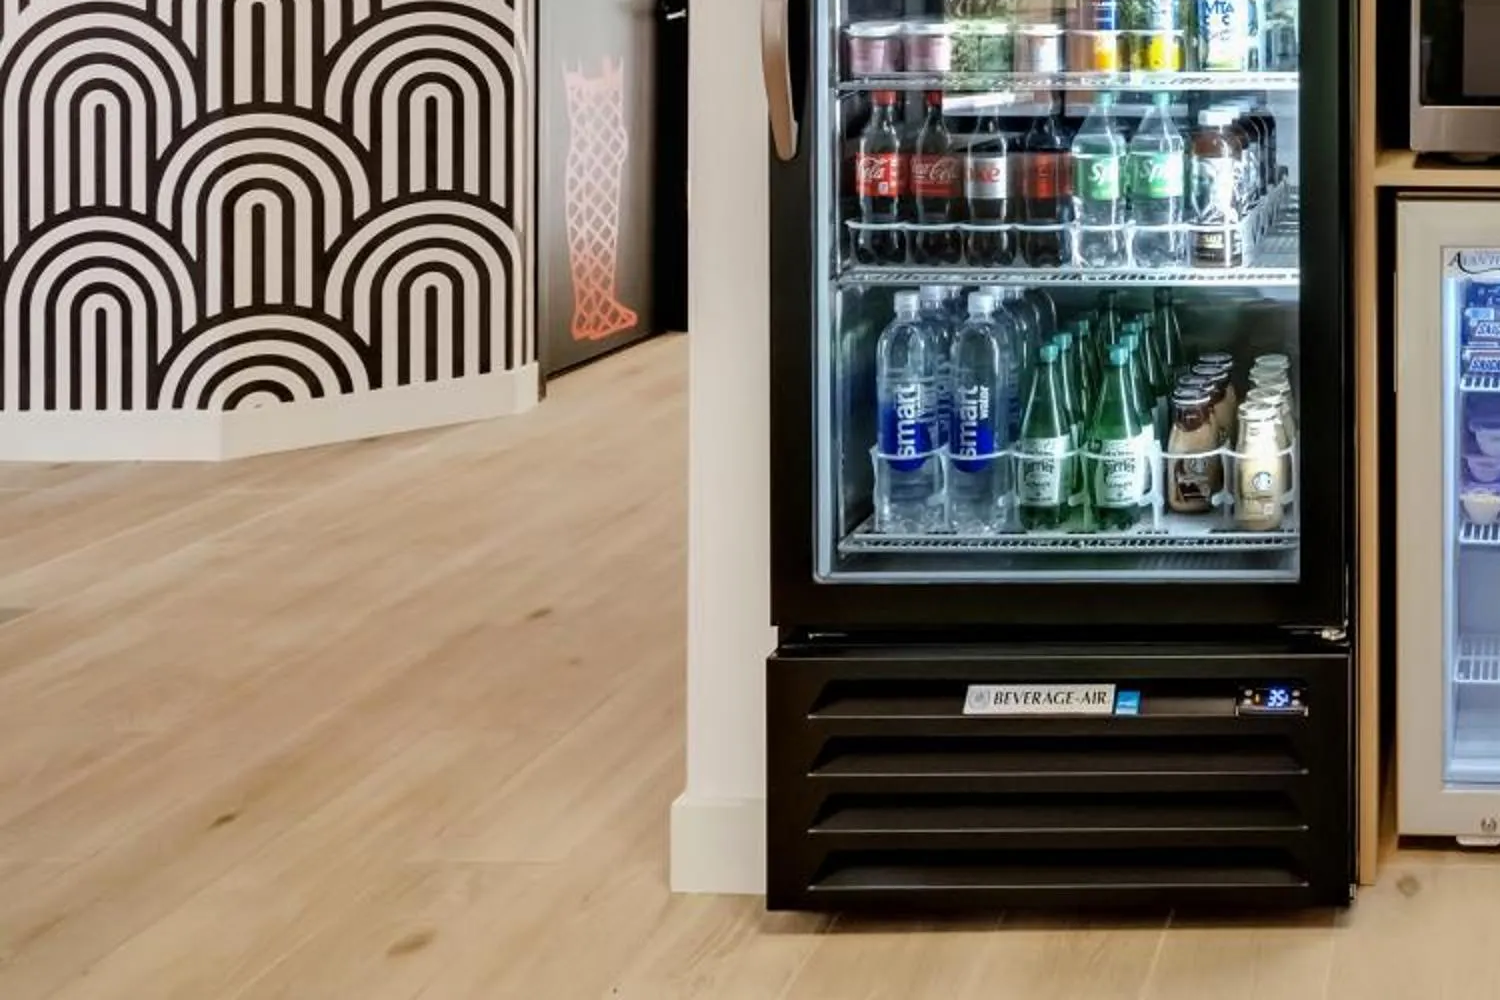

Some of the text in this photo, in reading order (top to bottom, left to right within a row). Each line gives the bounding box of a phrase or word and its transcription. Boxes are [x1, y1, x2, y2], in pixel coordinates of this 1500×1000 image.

[897, 383, 917, 457] smart
[957, 384, 979, 458] smart
[993, 691, 1107, 706] BEVERAGE-AIR
